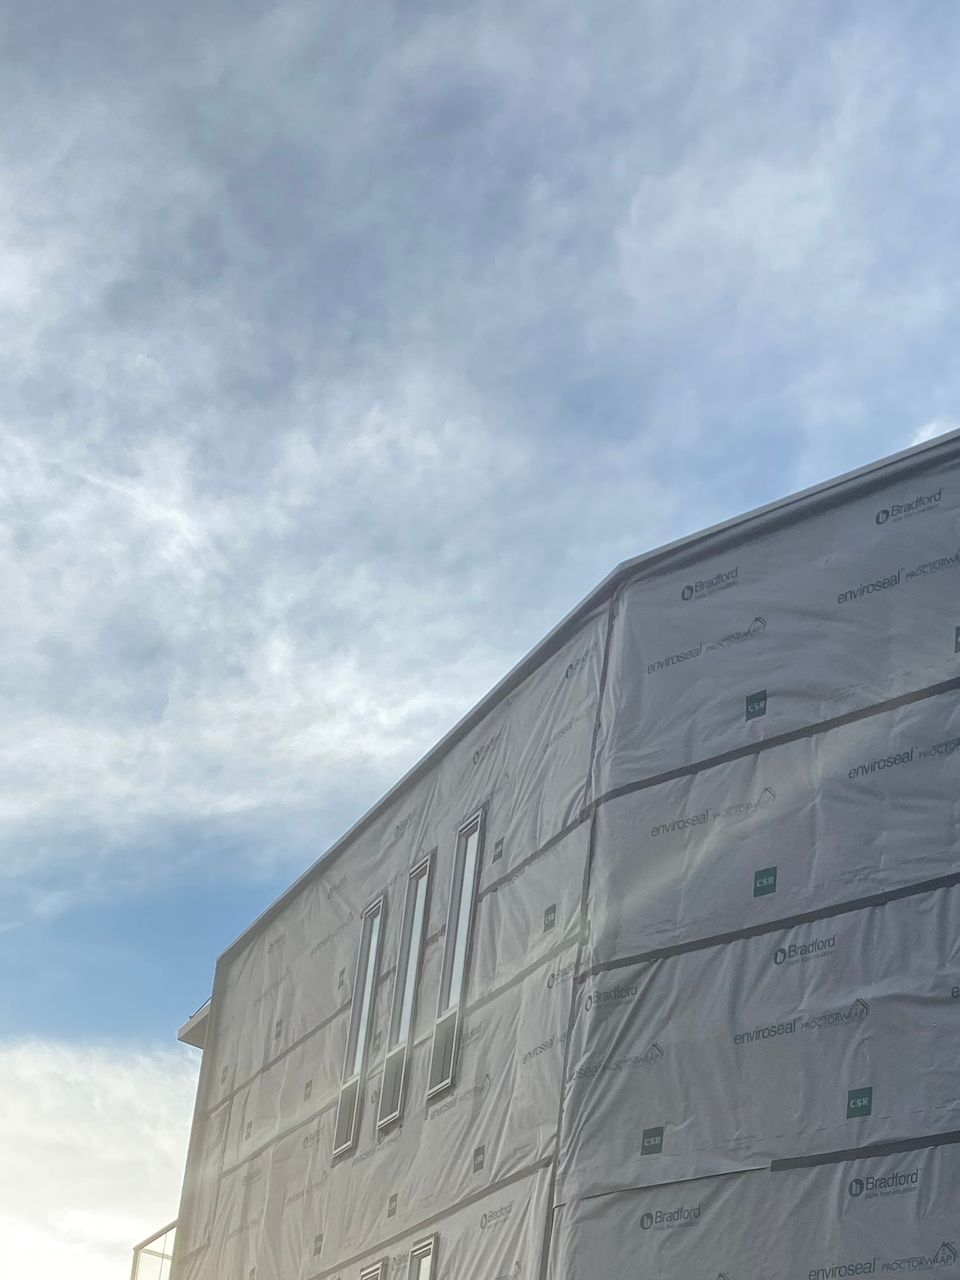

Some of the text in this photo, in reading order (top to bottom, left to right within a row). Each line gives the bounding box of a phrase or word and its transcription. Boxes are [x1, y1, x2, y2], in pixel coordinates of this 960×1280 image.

[891, 489, 941, 517] Bradford
[694, 567, 738, 593] Bradford
[837, 571, 901, 604] enviroseal
[647, 644, 702, 674] enviroseal
[848, 747, 914, 779] enviroseal
[651, 810, 709, 837] enviroseal
[756, 875, 774, 888] CSR
[788, 935, 836, 959] Bradford
[734, 1019, 796, 1046] enviroseal
[850, 1096, 870, 1108] CSR
[643, 1135, 662, 1147] CSR
[866, 1167, 918, 1191] Bradford
[654, 1204, 701, 1224] Bradford
[808, 1258, 876, 1280] enviroseal
